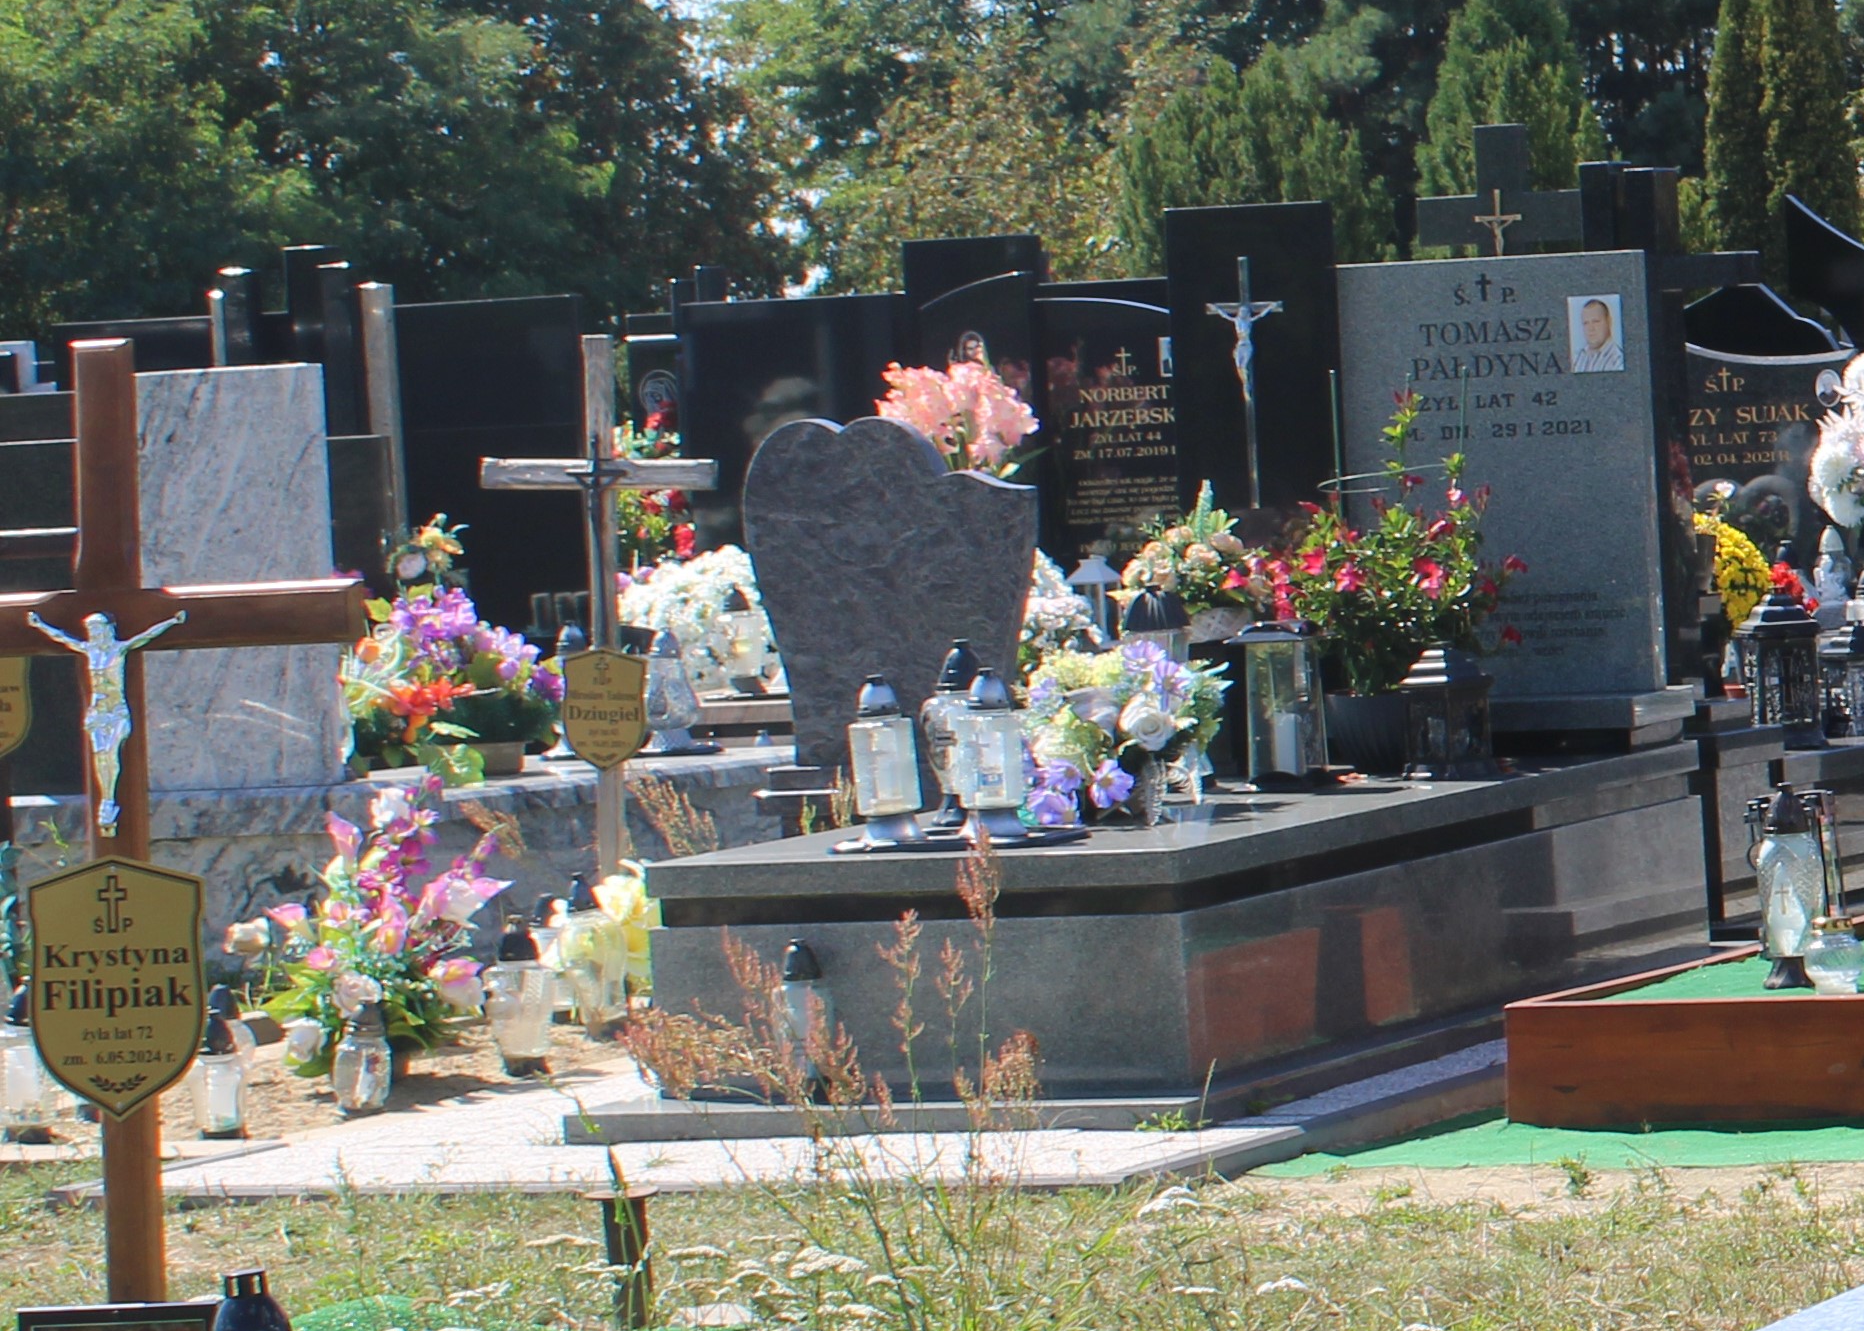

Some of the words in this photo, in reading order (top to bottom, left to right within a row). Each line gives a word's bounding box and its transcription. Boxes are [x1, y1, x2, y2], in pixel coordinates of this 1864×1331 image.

[1454, 284, 1470, 306] Ś.
[1501, 286, 1516, 303] P.
[1419, 317, 1553, 347] TOMASZ
[1411, 351, 1566, 381] PAŁDYNA
[1078, 385, 1170, 404] NORBERT
[1475, 393, 1515, 409] LAT
[1532, 390, 1558, 406] 42
[1070, 407, 1176, 429] JARZĘBSK
[1736, 404, 1811, 425] SUJAK
[1492, 423, 1517, 438] 29
[1542, 419, 1594, 436] 2021
[1719, 431, 1749, 445] LAT
[1758, 430, 1778, 443] 73
[43, 944, 190, 974] Krystyna
[41, 976, 193, 1018] Filipiak
[114, 1027, 132, 1040] lat
[137, 1025, 153, 1039] 72
